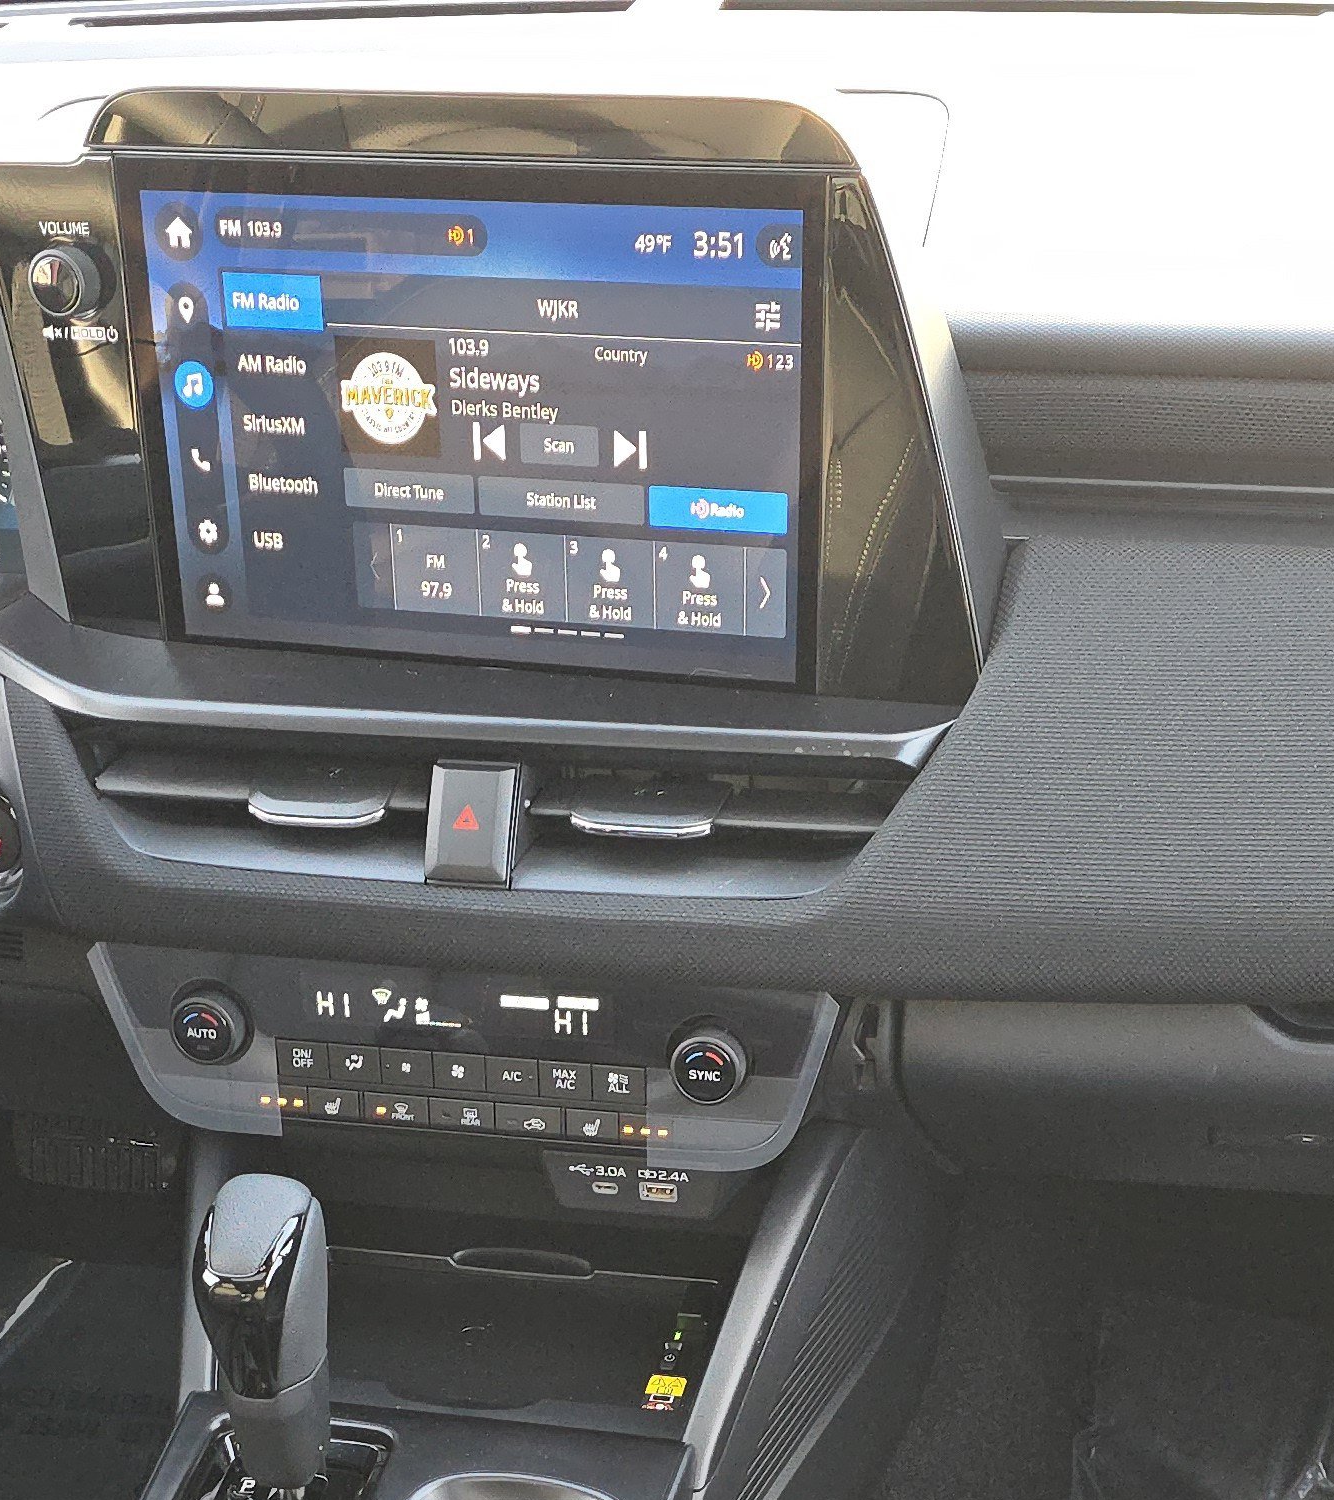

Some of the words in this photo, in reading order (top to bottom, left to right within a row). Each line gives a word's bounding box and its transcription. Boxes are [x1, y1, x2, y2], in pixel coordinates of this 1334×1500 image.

[39, 221, 90, 235] VOLUME
[219, 220, 242, 236] FM
[246, 220, 282, 238] 103.9
[635, 233, 672, 253] 49°F
[693, 231, 745, 258] 3:51
[232, 293, 255, 310] FM
[258, 293, 299, 312] Radio
[537, 298, 578, 321] WJKR
[448, 338, 489, 356] 103.9
[594, 346, 647, 366] Country
[238, 354, 263, 374] AM
[265, 354, 307, 377] Radio
[449, 368, 540, 393] Sideways
[347, 385, 431, 409] MAVERICK
[450, 400, 495, 421] Dierks
[498, 402, 559, 424] Bentley
[243, 414, 306, 435] SiriusXM
[543, 437, 575, 455] Scan
[248, 474, 318, 496] Bluetooth
[374, 482, 406, 500] Direct
[408, 484, 444, 502] Tune
[526, 491, 562, 510] Station
[564, 493, 596, 511] List
[253, 532, 283, 550] USB
[426, 555, 446, 570] FM
[421, 581, 452, 600] 97.9
[505, 578, 540, 596] Press
[592, 585, 627, 602] Press
[518, 597, 545, 615] Hold
[682, 591, 717, 609] Press
[605, 602, 632, 621] Hold
[694, 609, 721, 628] Hold
[187, 1026, 217, 1040] AUTO
[292, 1058, 313, 1068] OFF
[502, 1071, 522, 1082] A/C
[553, 1069, 576, 1080] MAX
[688, 1069, 721, 1083] SYNC
[555, 1079, 575, 1090] A/C
[608, 1083, 630, 1094] ALL
[595, 1166, 627, 1178] 3.0A
[658, 1170, 690, 1182] 2.4A
